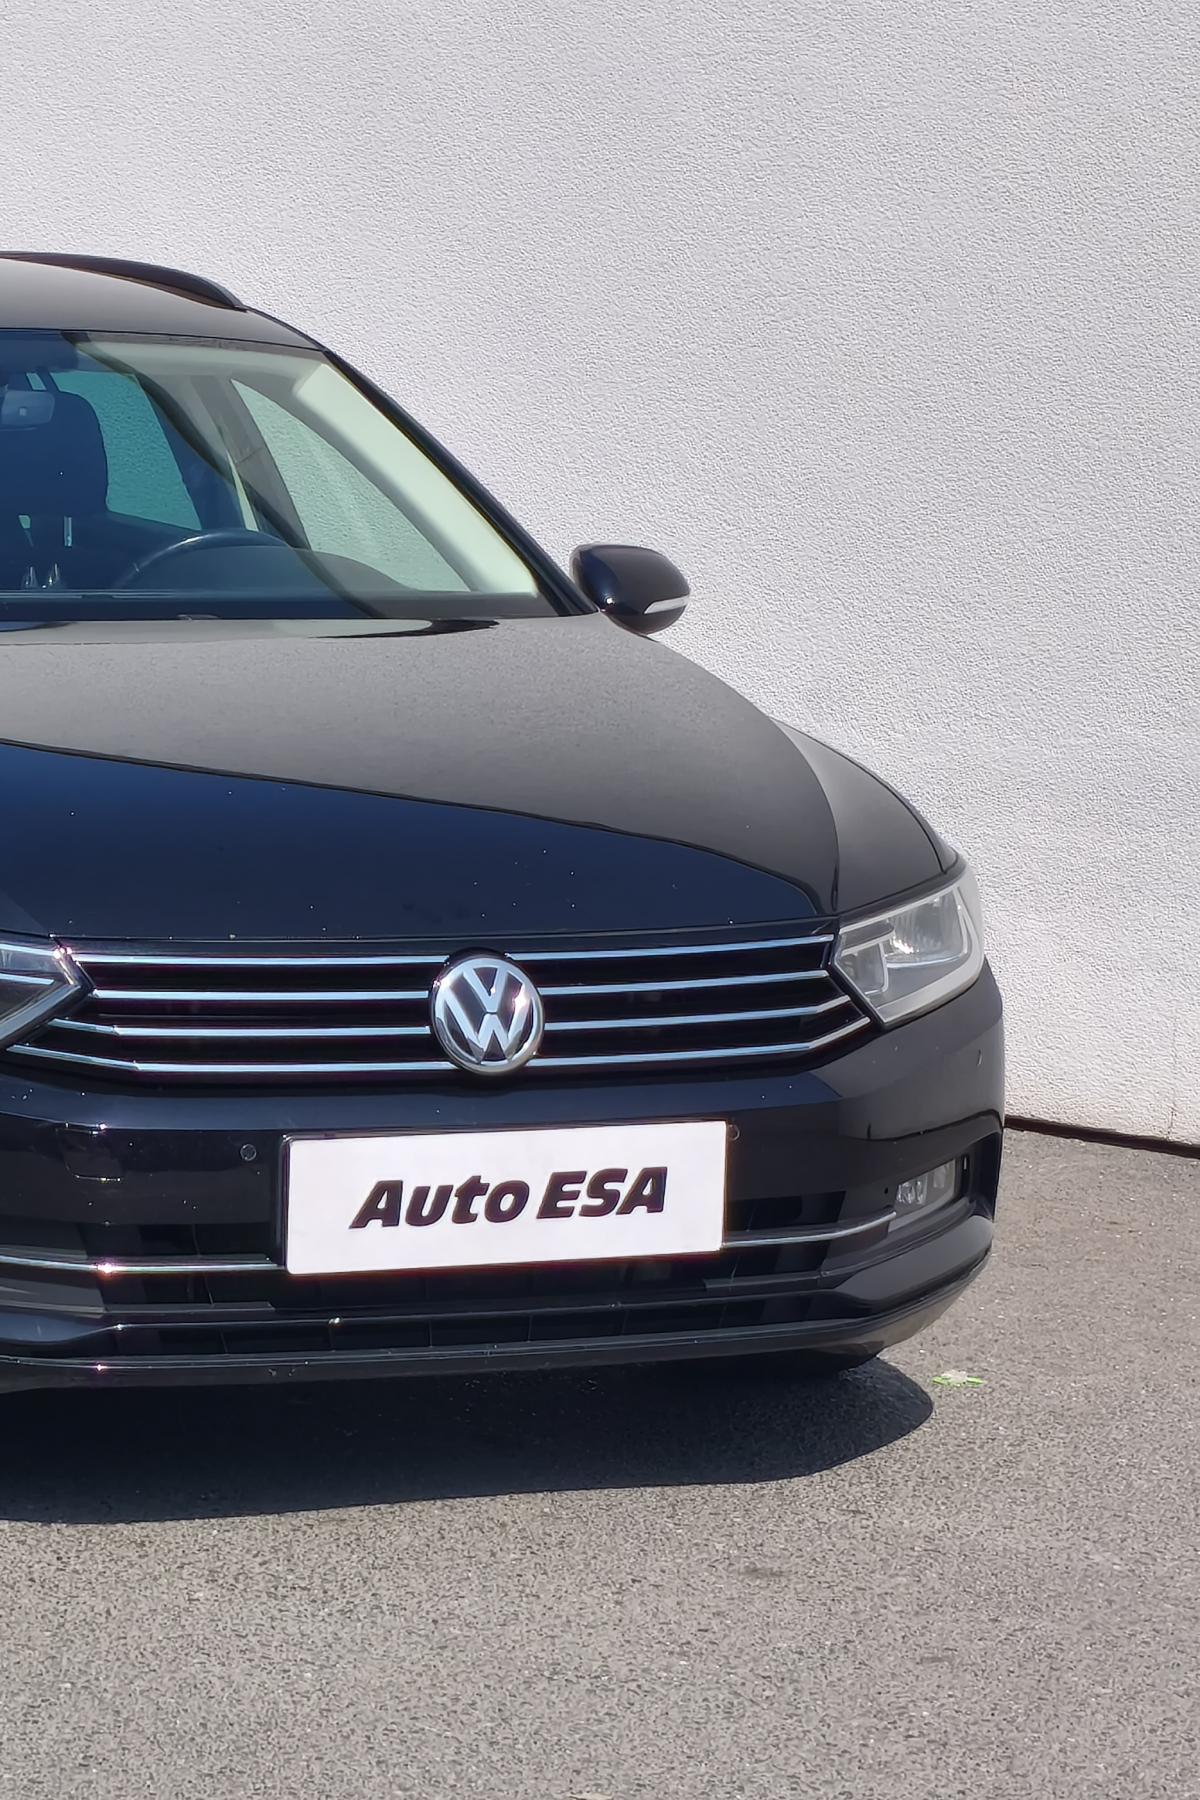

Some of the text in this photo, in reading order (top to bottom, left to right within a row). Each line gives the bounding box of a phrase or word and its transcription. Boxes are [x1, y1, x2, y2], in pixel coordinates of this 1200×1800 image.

[434, 957, 541, 1072] VW
[349, 1166, 668, 1229] Auto ESA
